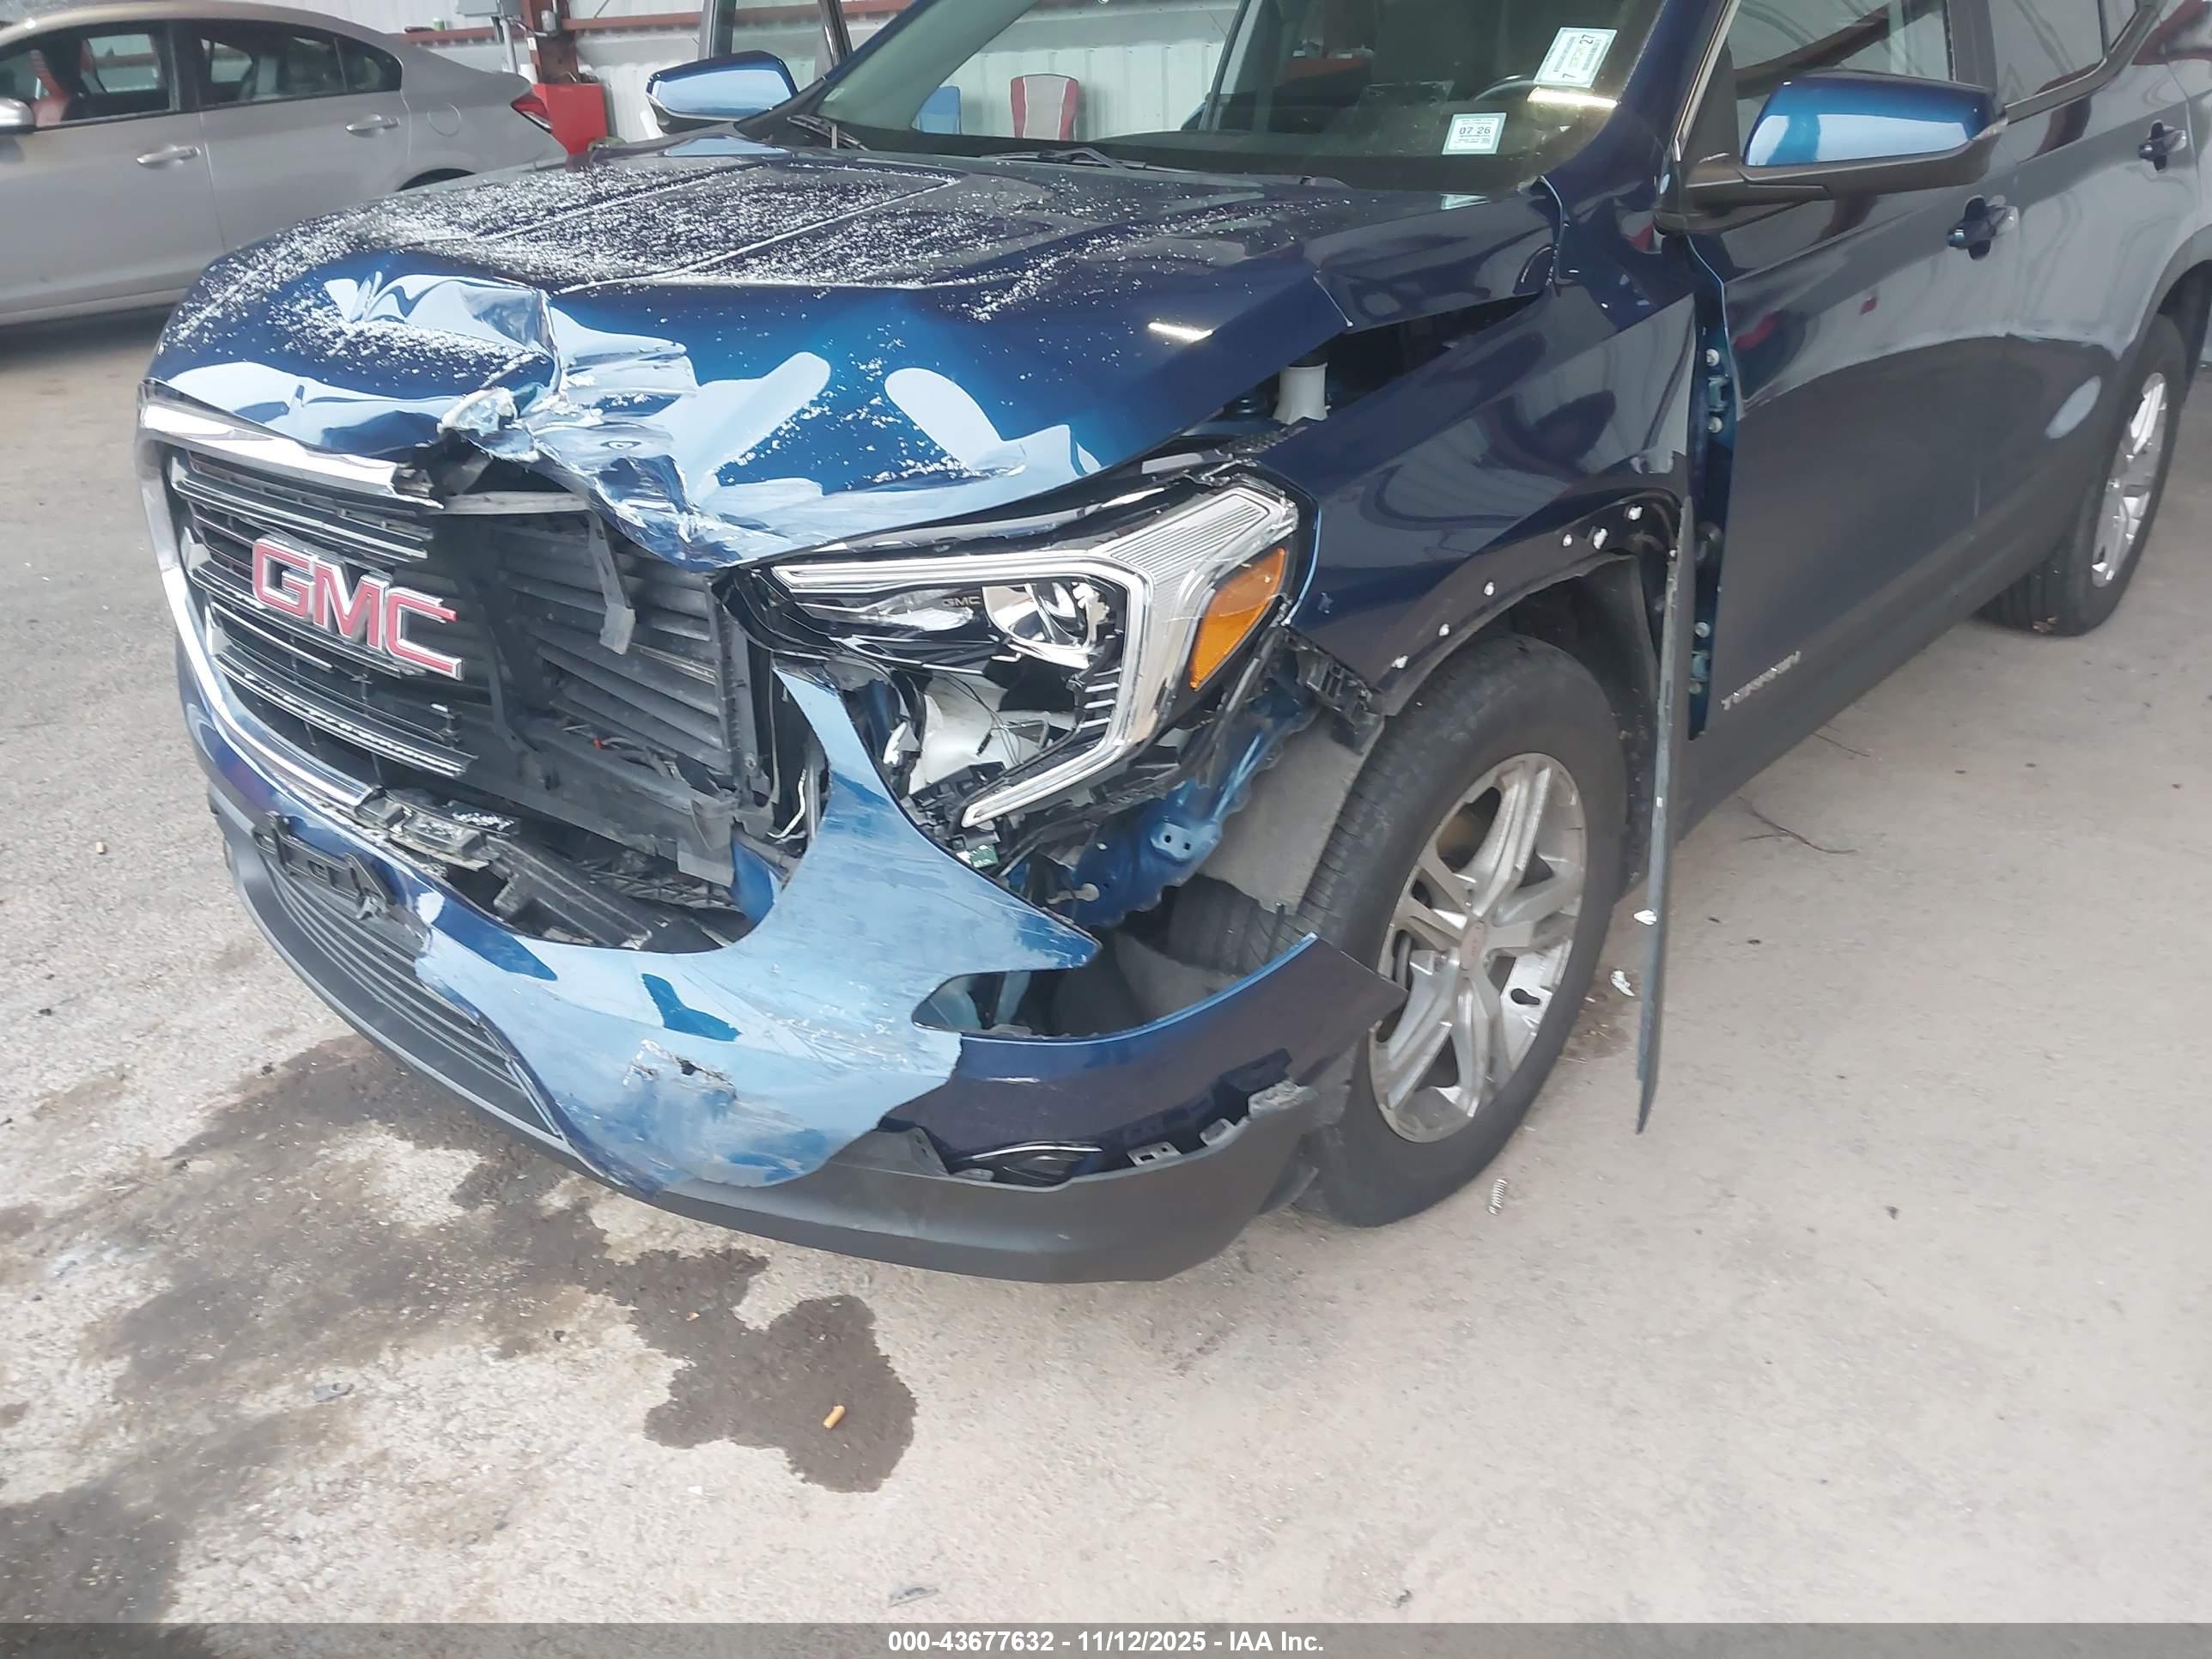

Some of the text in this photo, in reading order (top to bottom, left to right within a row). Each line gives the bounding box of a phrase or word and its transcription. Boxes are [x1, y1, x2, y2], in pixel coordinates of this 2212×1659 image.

[1579, 33, 1595, 45] 27
[1459, 126, 1492, 135] 07 26
[941, 596, 981, 606] GMC
[252, 538, 465, 682] GMC
